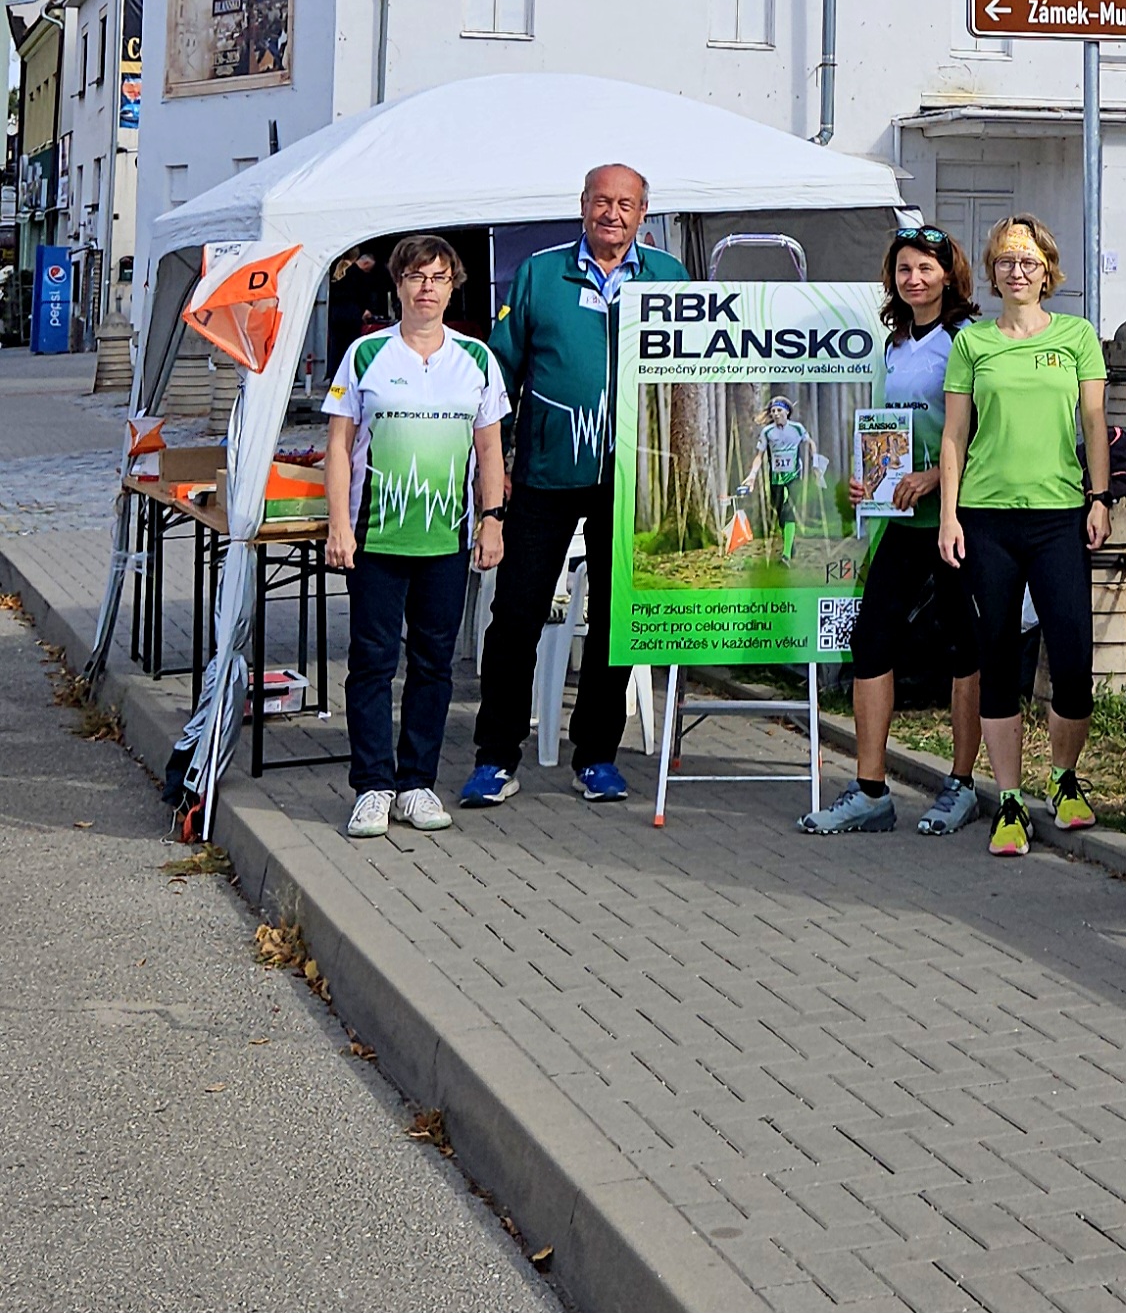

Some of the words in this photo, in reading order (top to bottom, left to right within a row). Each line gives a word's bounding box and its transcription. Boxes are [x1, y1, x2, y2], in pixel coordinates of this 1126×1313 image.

[127, 37, 142, 60] C
[248, 271, 269, 290] D
[49, 290, 62, 327] pepsi
[640, 293, 740, 322] RBK
[639, 328, 874, 359] BLANSKO
[638, 363, 697, 375] Bezpečný
[698, 365, 744, 375] prostor
[746, 366, 767, 375] pro
[768, 365, 806, 376] rozvoj
[807, 363, 845, 375] vašich
[847, 363, 873, 374] dětí.
[1034, 352, 1068, 373] RBK
[858, 421, 897, 430] BLANSKO
[859, 414, 875, 422] RBK
[774, 457, 791, 468] 517
[826, 558, 865, 584] RBK
[631, 603, 660, 616] Přijď
[663, 603, 701, 615] zkusit
[705, 603, 768, 615] orientační
[770, 602, 798, 614] běh.
[631, 620, 669, 633] Sport
[670, 623, 692, 633] pro
[695, 620, 730, 632] celou
[732, 620, 772, 631] rodinu
[630, 637, 663, 650] Začít
[665, 636, 708, 650] můžeš
[711, 640, 720, 649] v
[721, 637, 772, 649] každém
[775, 636, 808, 649] věku!
